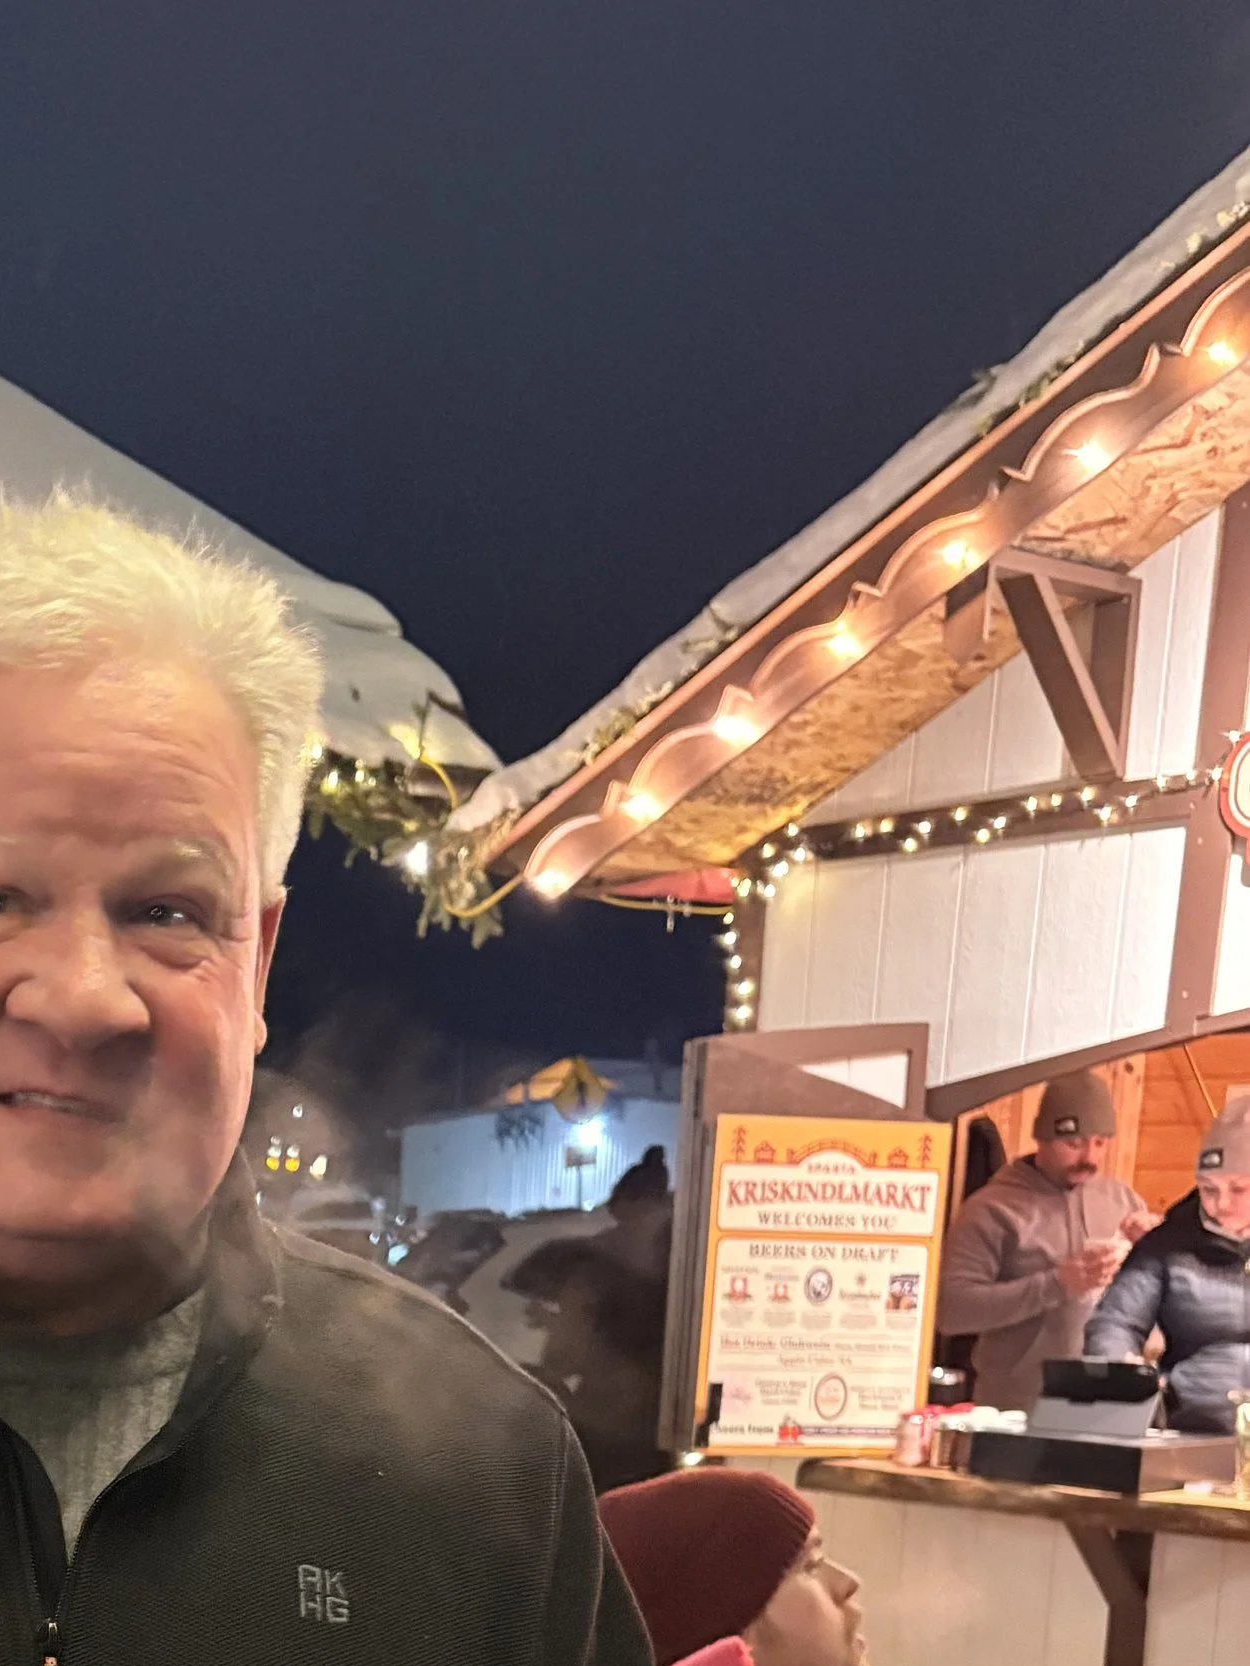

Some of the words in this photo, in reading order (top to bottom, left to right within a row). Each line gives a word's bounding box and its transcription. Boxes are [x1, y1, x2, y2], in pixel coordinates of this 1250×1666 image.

[727, 1179, 931, 1214] KRISKINDLMARKT
[758, 1211, 855, 1228] WELCOMES
[861, 1214, 896, 1230] YOU
[749, 1243, 807, 1261] BEERS
[811, 1244, 839, 1261] ON
[842, 1246, 899, 1264] DRAFT
[299, 1590, 350, 1622] HG
